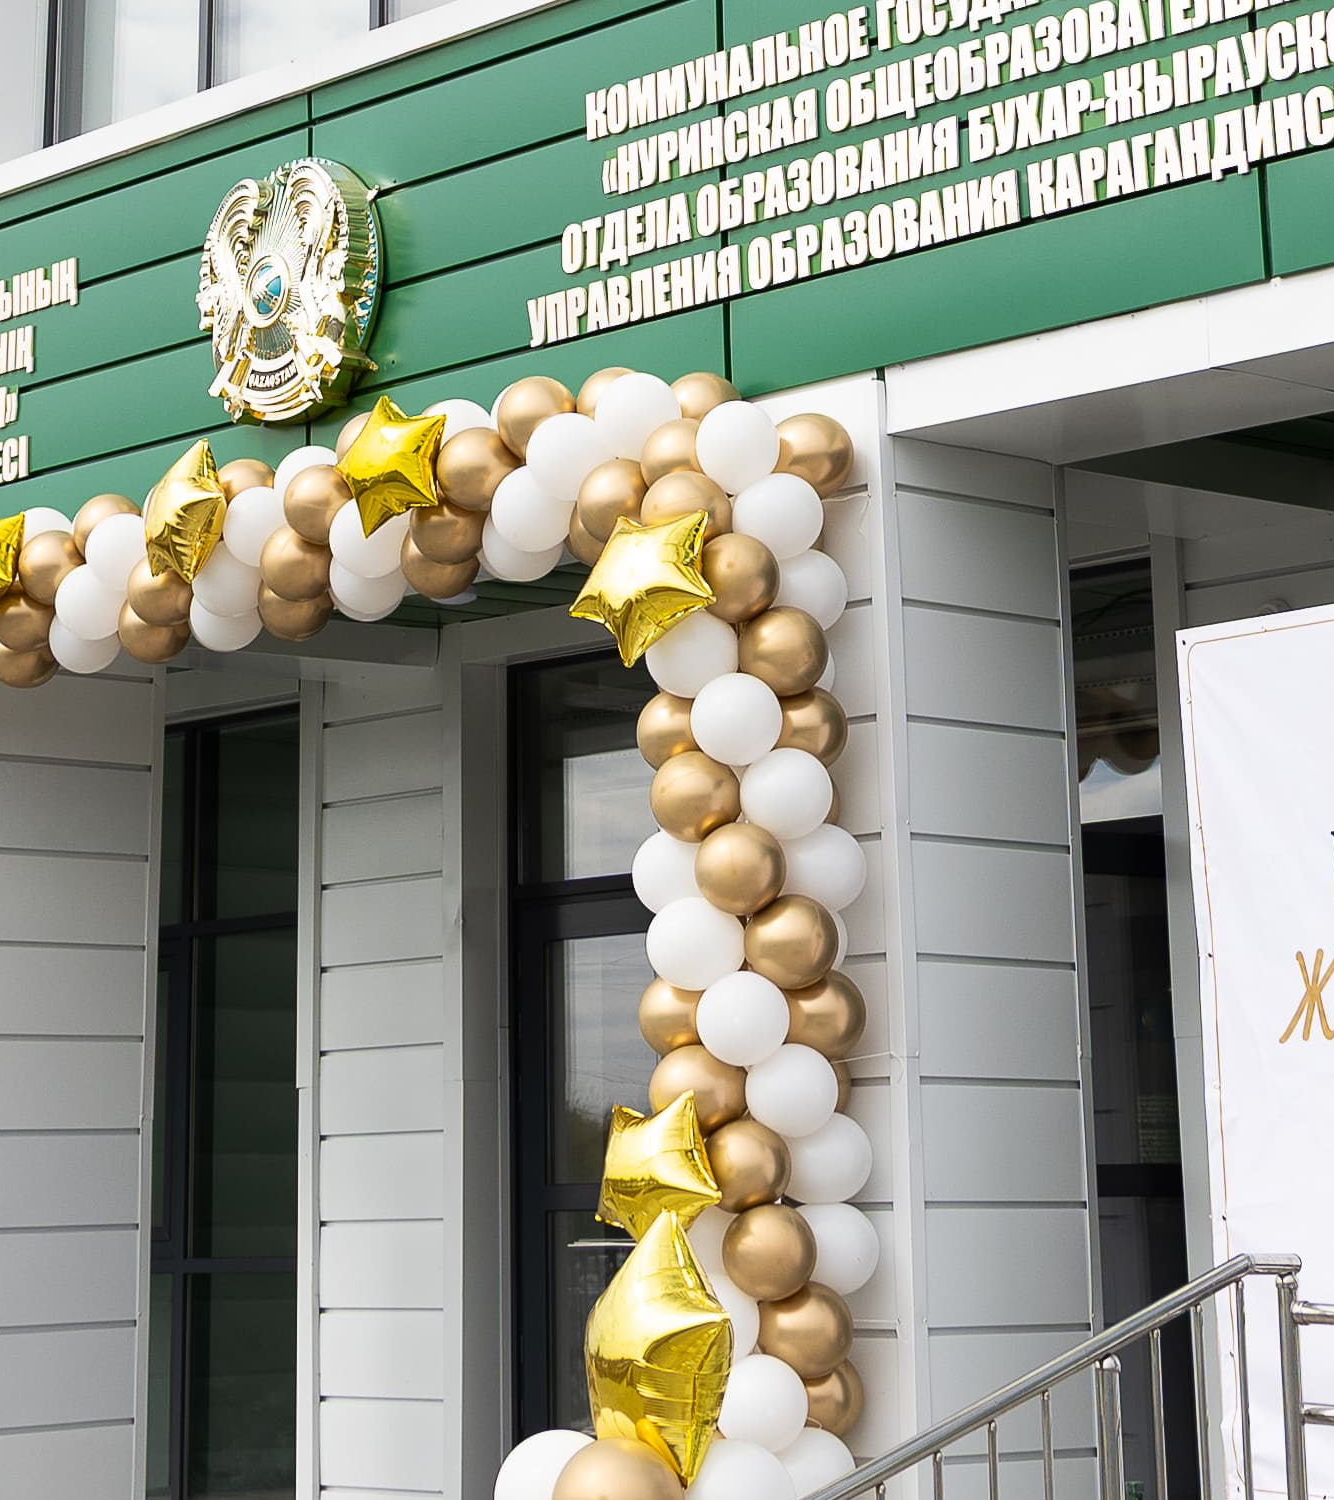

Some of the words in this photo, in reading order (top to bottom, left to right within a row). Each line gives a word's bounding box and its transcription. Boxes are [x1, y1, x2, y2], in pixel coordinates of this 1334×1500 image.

[586, 6, 870, 142] КОММУНАЛЬНОЕ
[602, 88, 819, 194] «НУРИНСКАЯ
[527, 245, 741, 347] УПРАВЛЕНИЯ
[748, 169, 1020, 290] ОБРАЗОВАНИЯ
[562, 193, 691, 273] ОТДЕЛА
[696, 116, 959, 237] ОБРАЗОВАНИЯ
